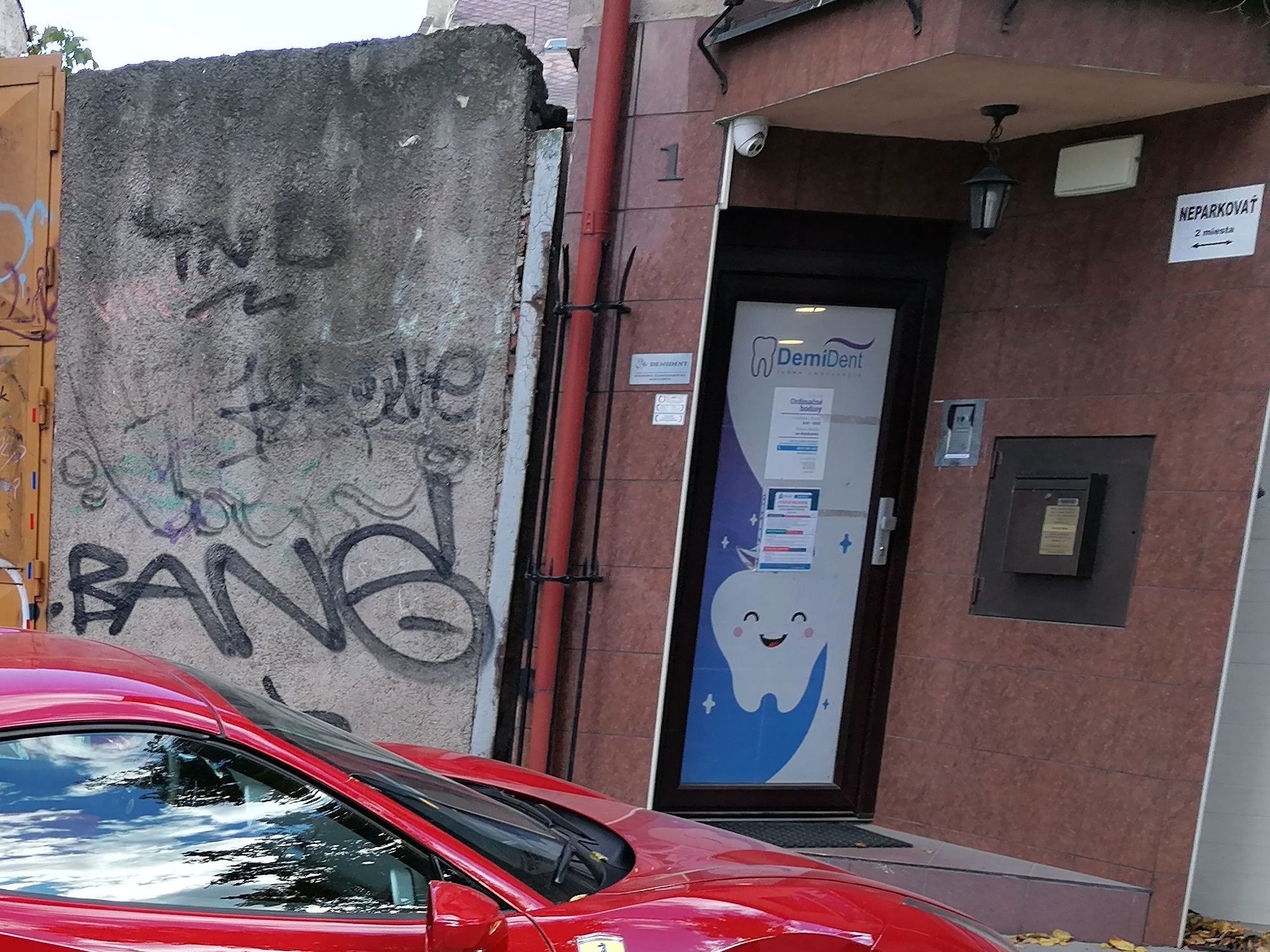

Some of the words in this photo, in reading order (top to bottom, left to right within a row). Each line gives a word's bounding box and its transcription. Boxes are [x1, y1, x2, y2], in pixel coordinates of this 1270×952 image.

[657, 143, 685, 182] 1
[1178, 194, 1259, 222] NEPARKOVAŤ
[1194, 229, 1202, 238] 2
[1202, 227, 1235, 237] miesta
[777, 348, 863, 369] DemiDent
